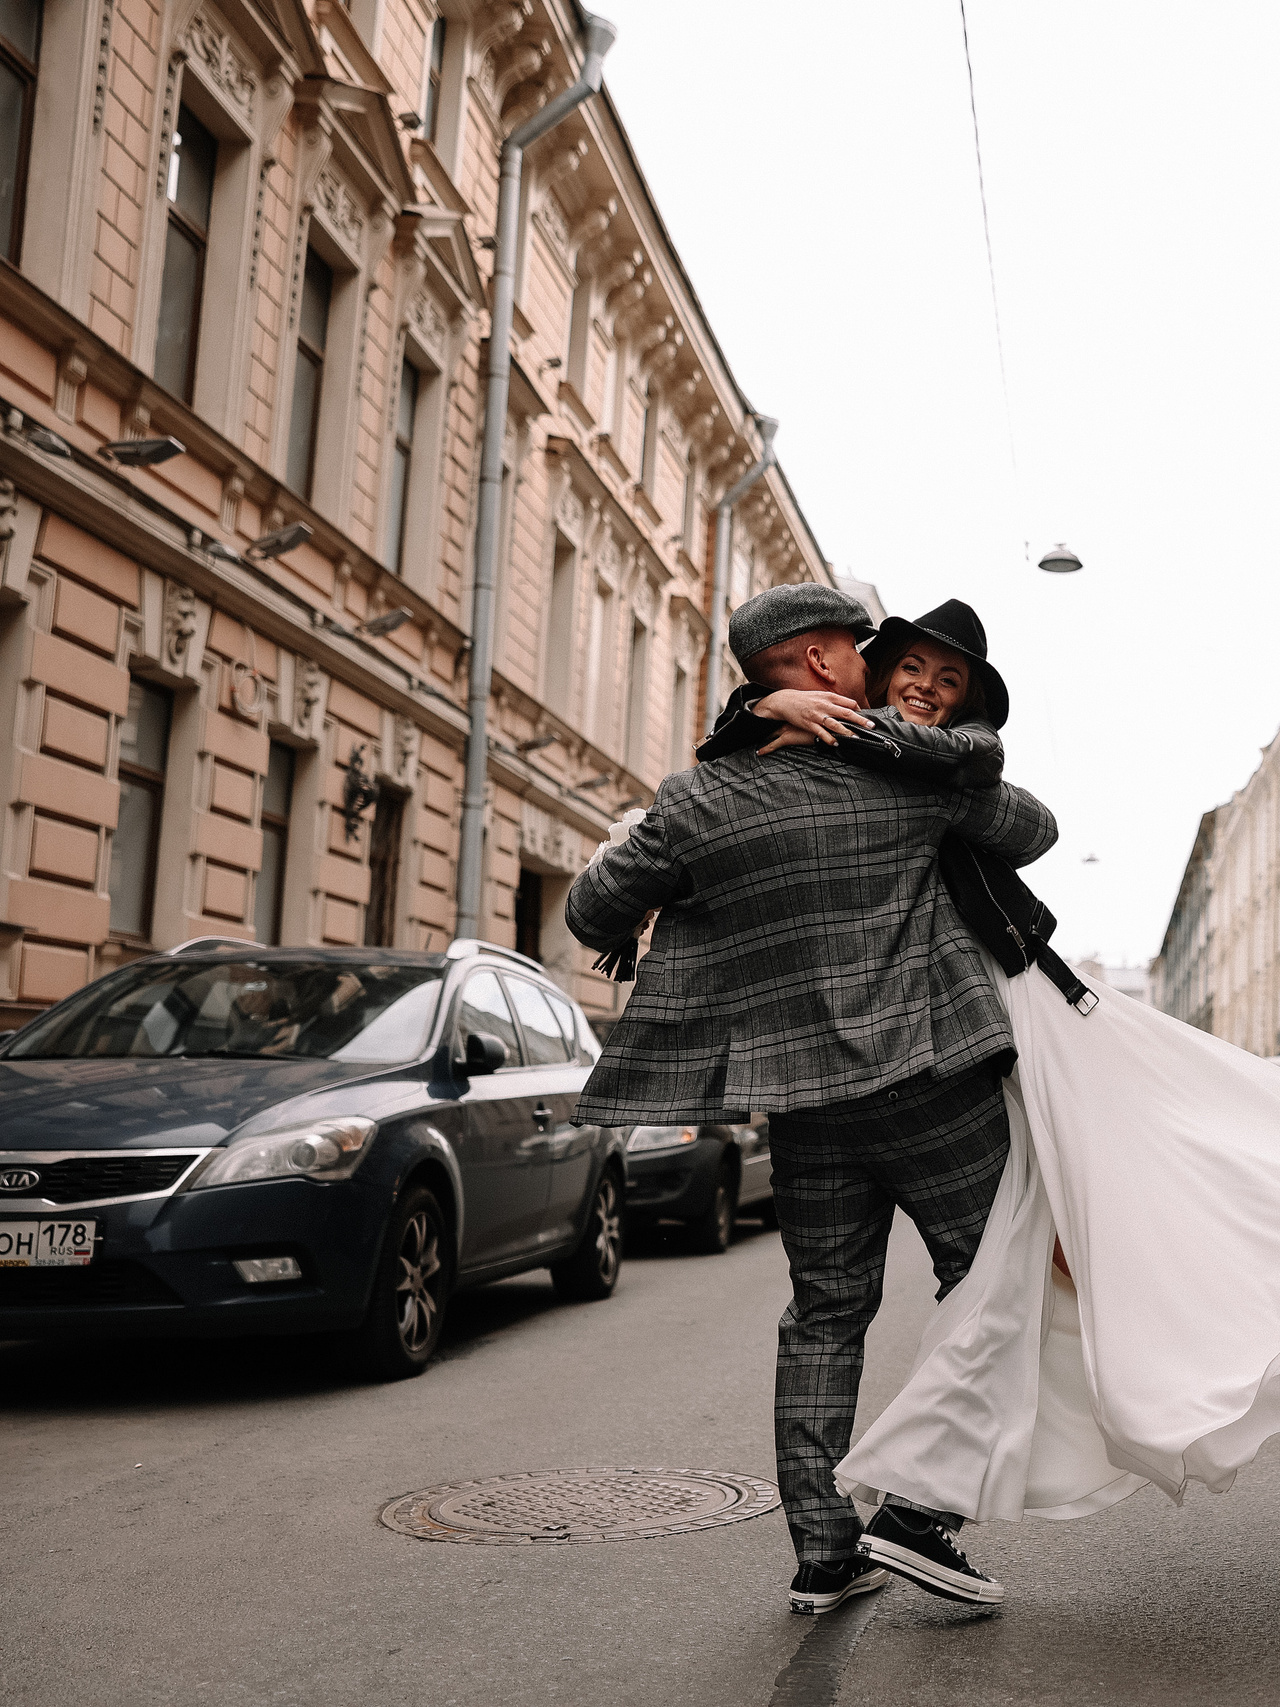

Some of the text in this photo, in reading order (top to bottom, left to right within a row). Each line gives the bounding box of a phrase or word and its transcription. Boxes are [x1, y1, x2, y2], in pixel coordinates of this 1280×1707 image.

[0, 1174, 30, 1186] KIA
[42, 1223, 87, 1247] 178
[50, 1246, 74, 1256] RUS
